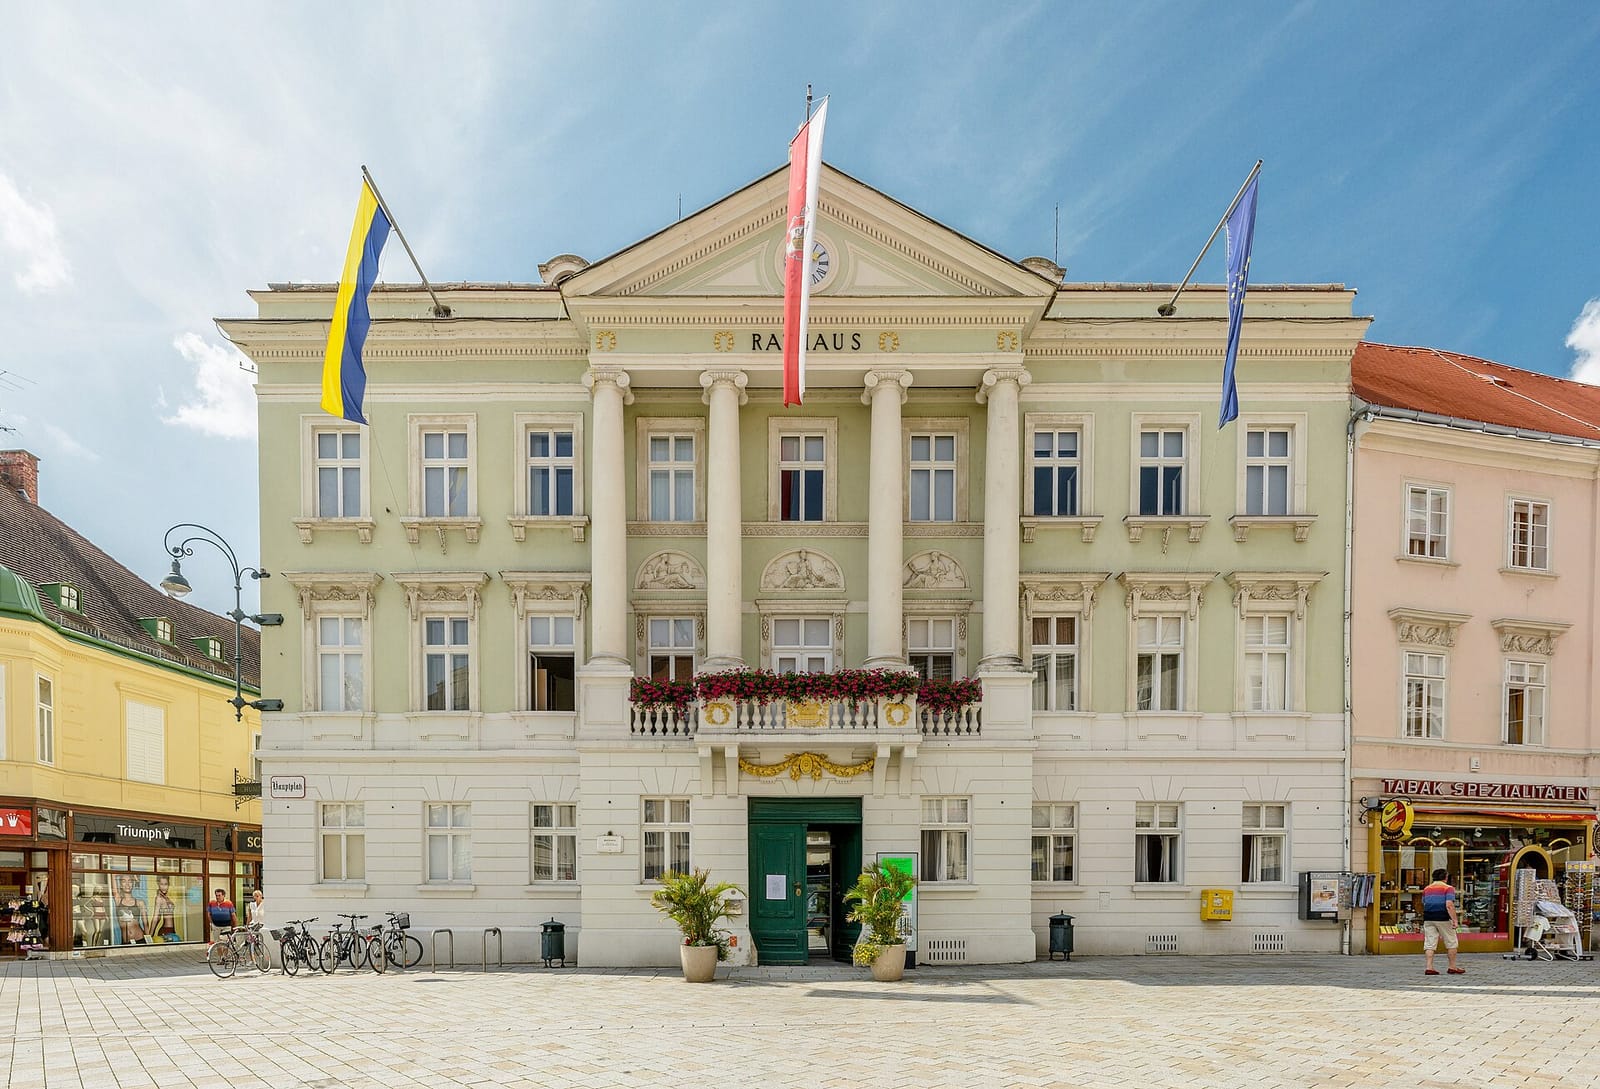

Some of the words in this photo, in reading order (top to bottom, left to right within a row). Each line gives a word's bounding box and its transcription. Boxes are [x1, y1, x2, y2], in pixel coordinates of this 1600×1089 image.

[752, 332, 861, 351] RAAUS
[1384, 779, 1444, 795] TABAK
[1453, 783, 1589, 800] SPEZIALITÄTEN
[117, 825, 162, 841] Triumph
[247, 836, 262, 848] SC
